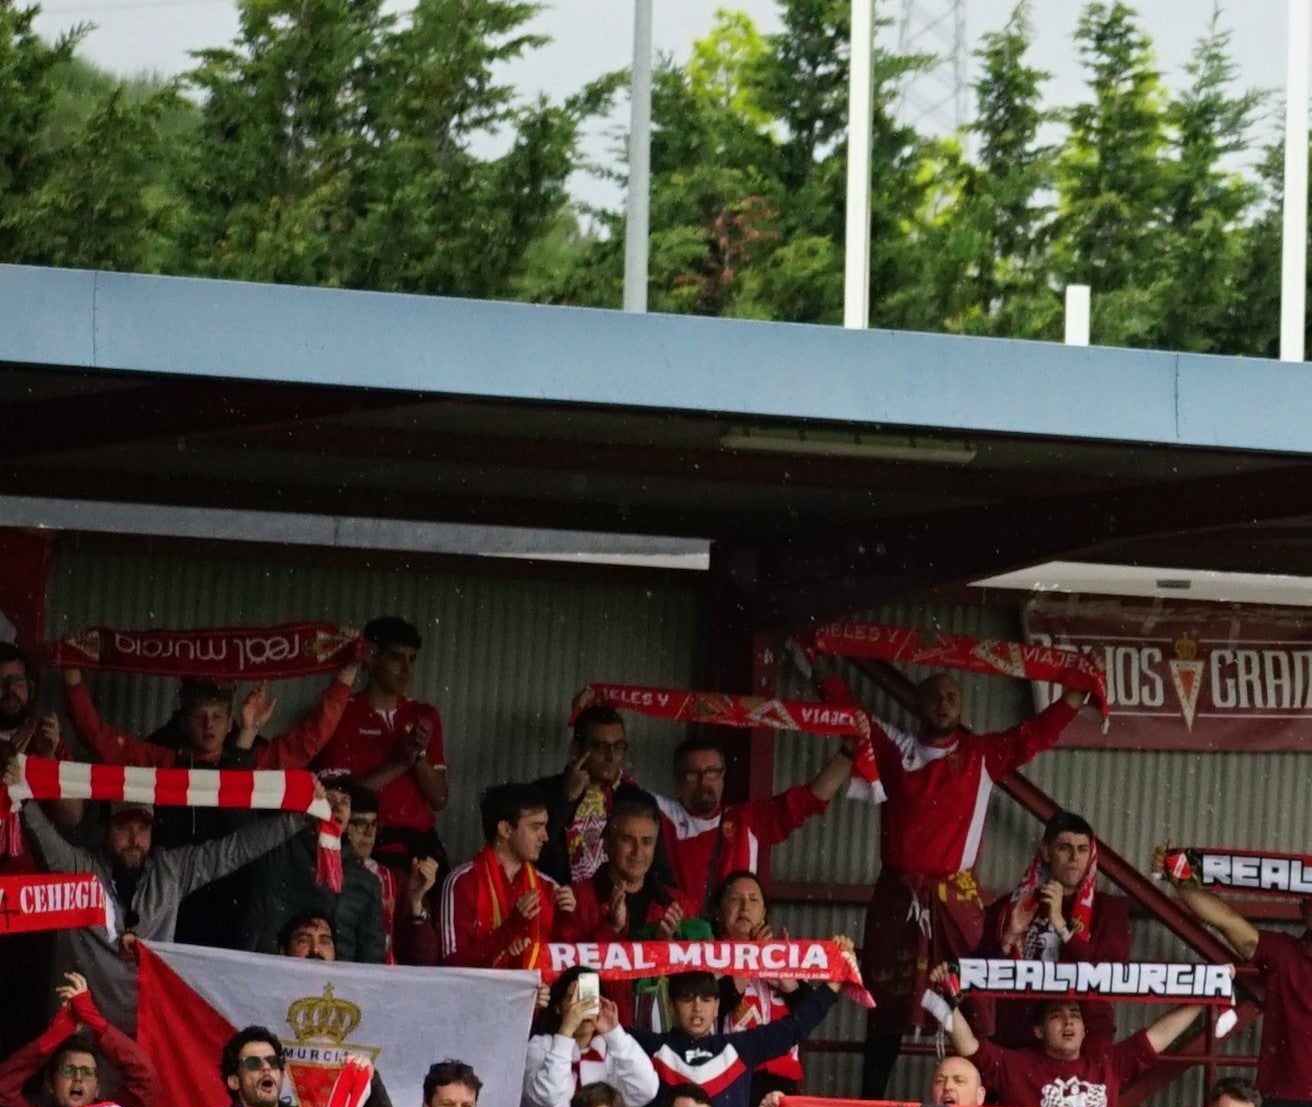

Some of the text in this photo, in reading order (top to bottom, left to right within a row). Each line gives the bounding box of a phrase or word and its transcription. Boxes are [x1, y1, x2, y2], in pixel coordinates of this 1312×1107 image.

[115, 632, 300, 670] real murcia
[548, 942, 829, 972] REAL MURCIA
[959, 958, 1232, 997] REAL MURCIA
